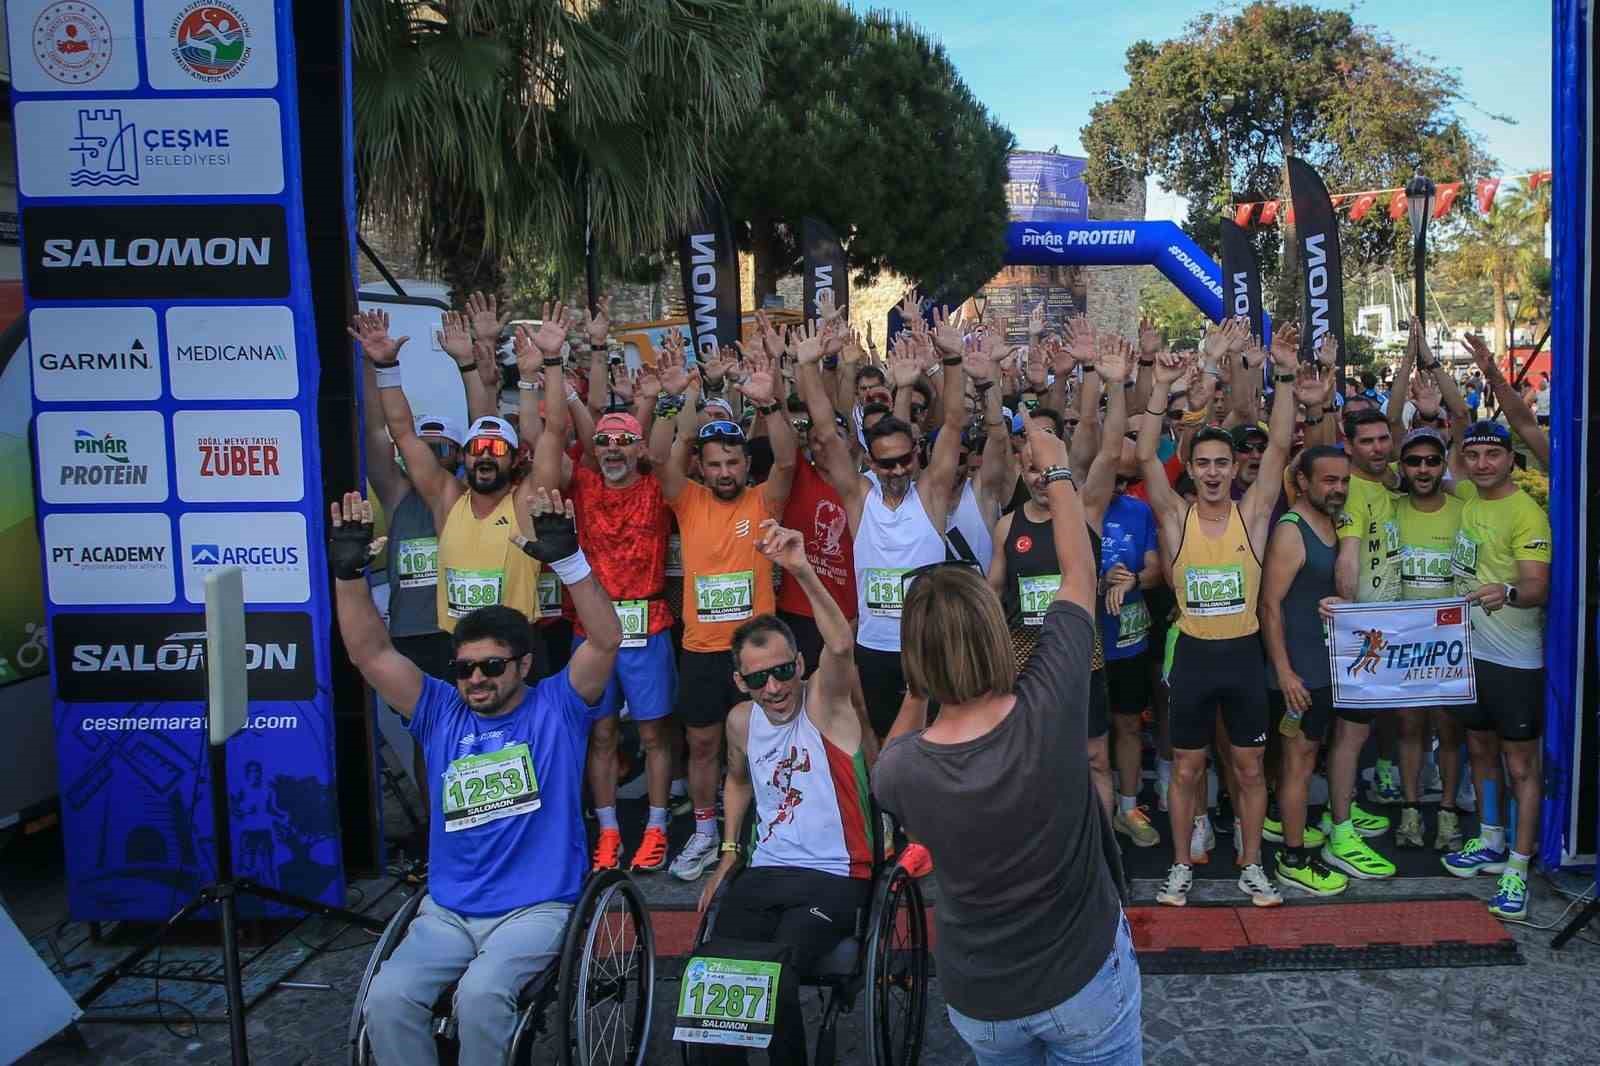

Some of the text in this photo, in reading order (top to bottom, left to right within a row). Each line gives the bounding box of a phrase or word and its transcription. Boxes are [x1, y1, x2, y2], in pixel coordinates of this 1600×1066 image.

[143, 129, 230, 151] ÇEŞME
[145, 152, 231, 166] BELEDİYESİ
[41, 237, 271, 268] SALOMON
[40, 352, 150, 370] GARMIN
[177, 345, 275, 361] MEDICANA
[198, 445, 280, 476] ZÜBER
[52, 546, 166, 566] PT_ACADEMY
[222, 547, 299, 564] ARGEUS
[402, 552, 438, 572] 101
[450, 582, 497, 604] 1138
[701, 586, 747, 608] 1267
[870, 582, 903, 601] 131
[1190, 579, 1237, 601] 1023
[1386, 640, 1463, 669] TEMPO
[449, 768, 524, 808] 1253
[467, 799, 514, 815] SALOMON
[690, 982, 765, 1019] 1287
[702, 1019, 748, 1031] SALOMON
